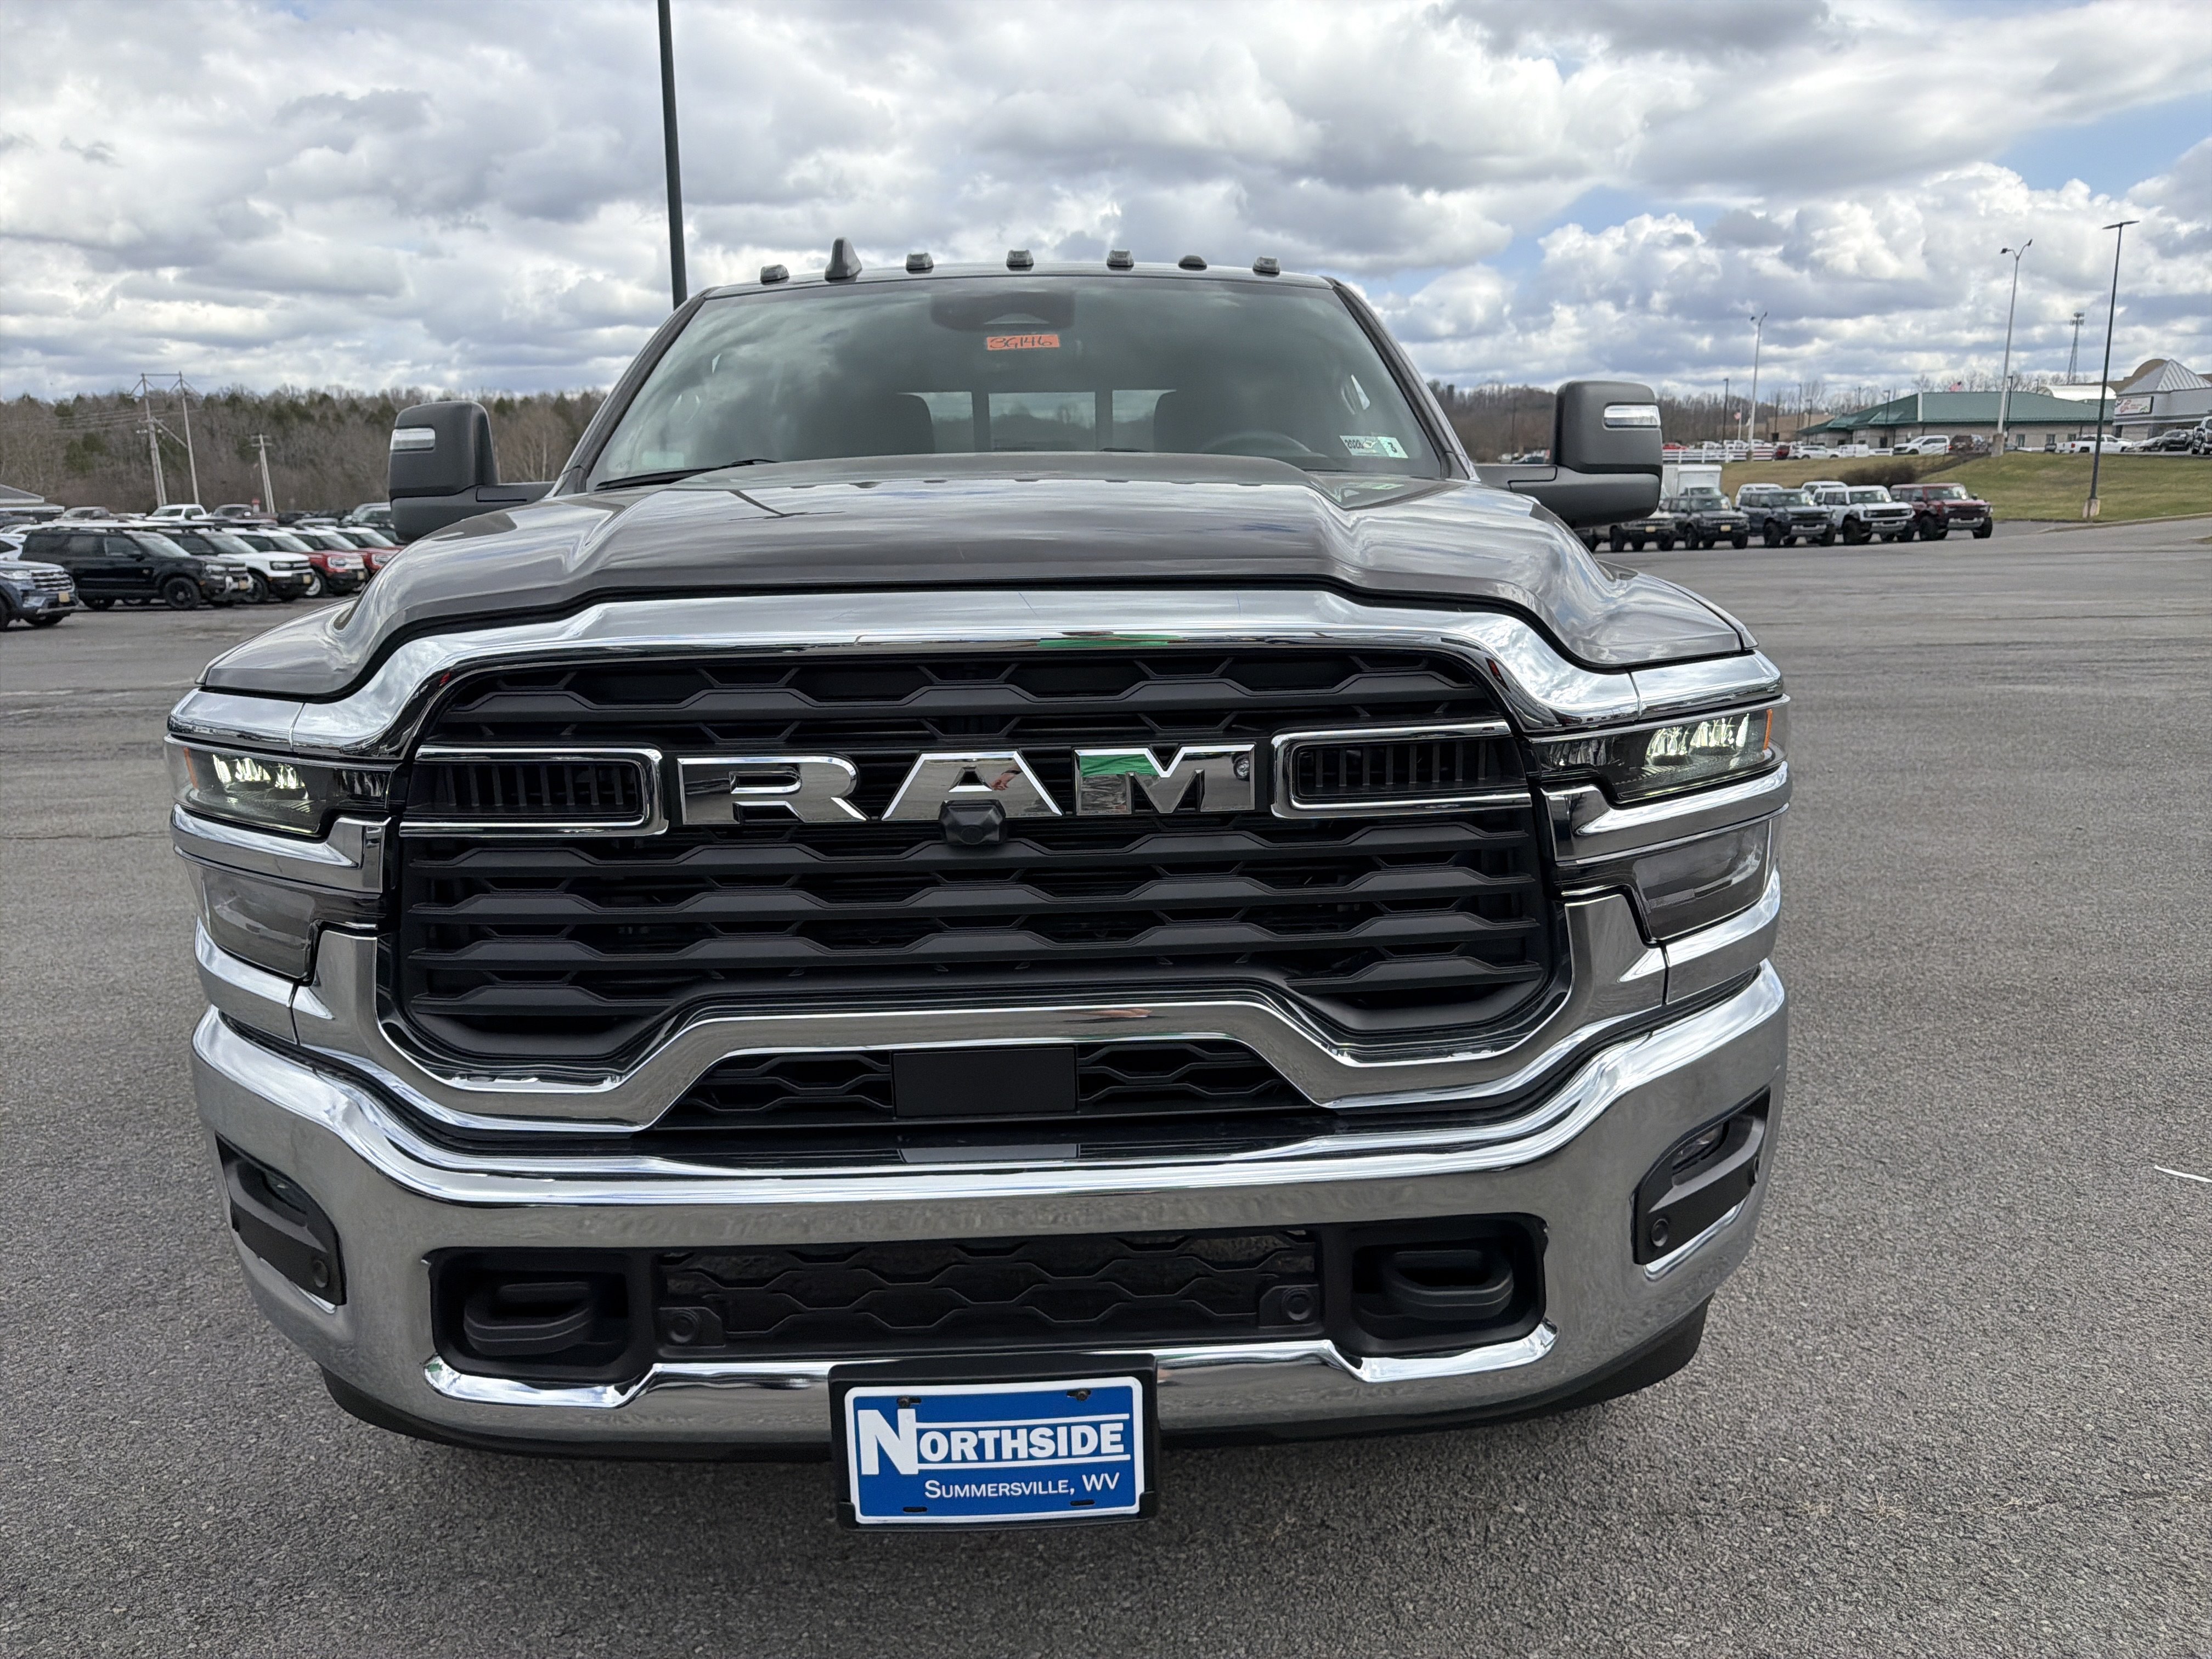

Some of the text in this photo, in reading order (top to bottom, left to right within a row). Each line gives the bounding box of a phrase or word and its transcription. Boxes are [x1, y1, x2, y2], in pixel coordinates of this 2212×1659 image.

[676, 743, 1257, 826] RAM
[857, 1408, 1125, 1475] NORTHSIDE
[1082, 1472, 1120, 1492] WV
